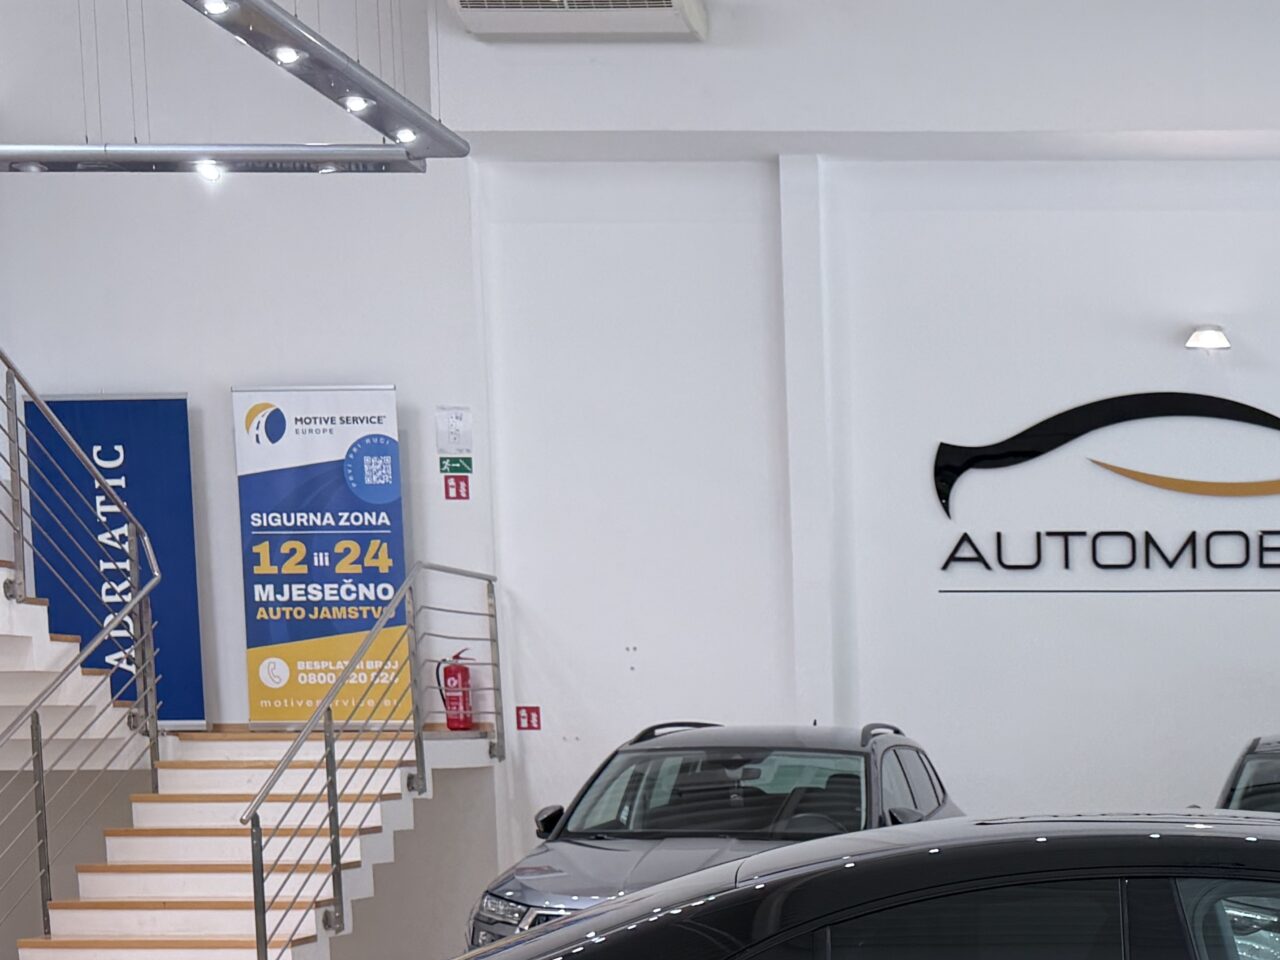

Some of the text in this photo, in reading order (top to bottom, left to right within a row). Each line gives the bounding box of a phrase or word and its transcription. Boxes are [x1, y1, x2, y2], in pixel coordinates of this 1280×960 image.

[294, 416, 336, 425] MOTIVE
[250, 511, 391, 527] SIGURNA ZONA
[252, 539, 393, 574] 12 ili 24
[253, 579, 395, 602] MJESEČNO
[256, 606, 306, 620] AUTO
[298, 672, 336, 685] 0800
[339, 672, 368, 685] 20
